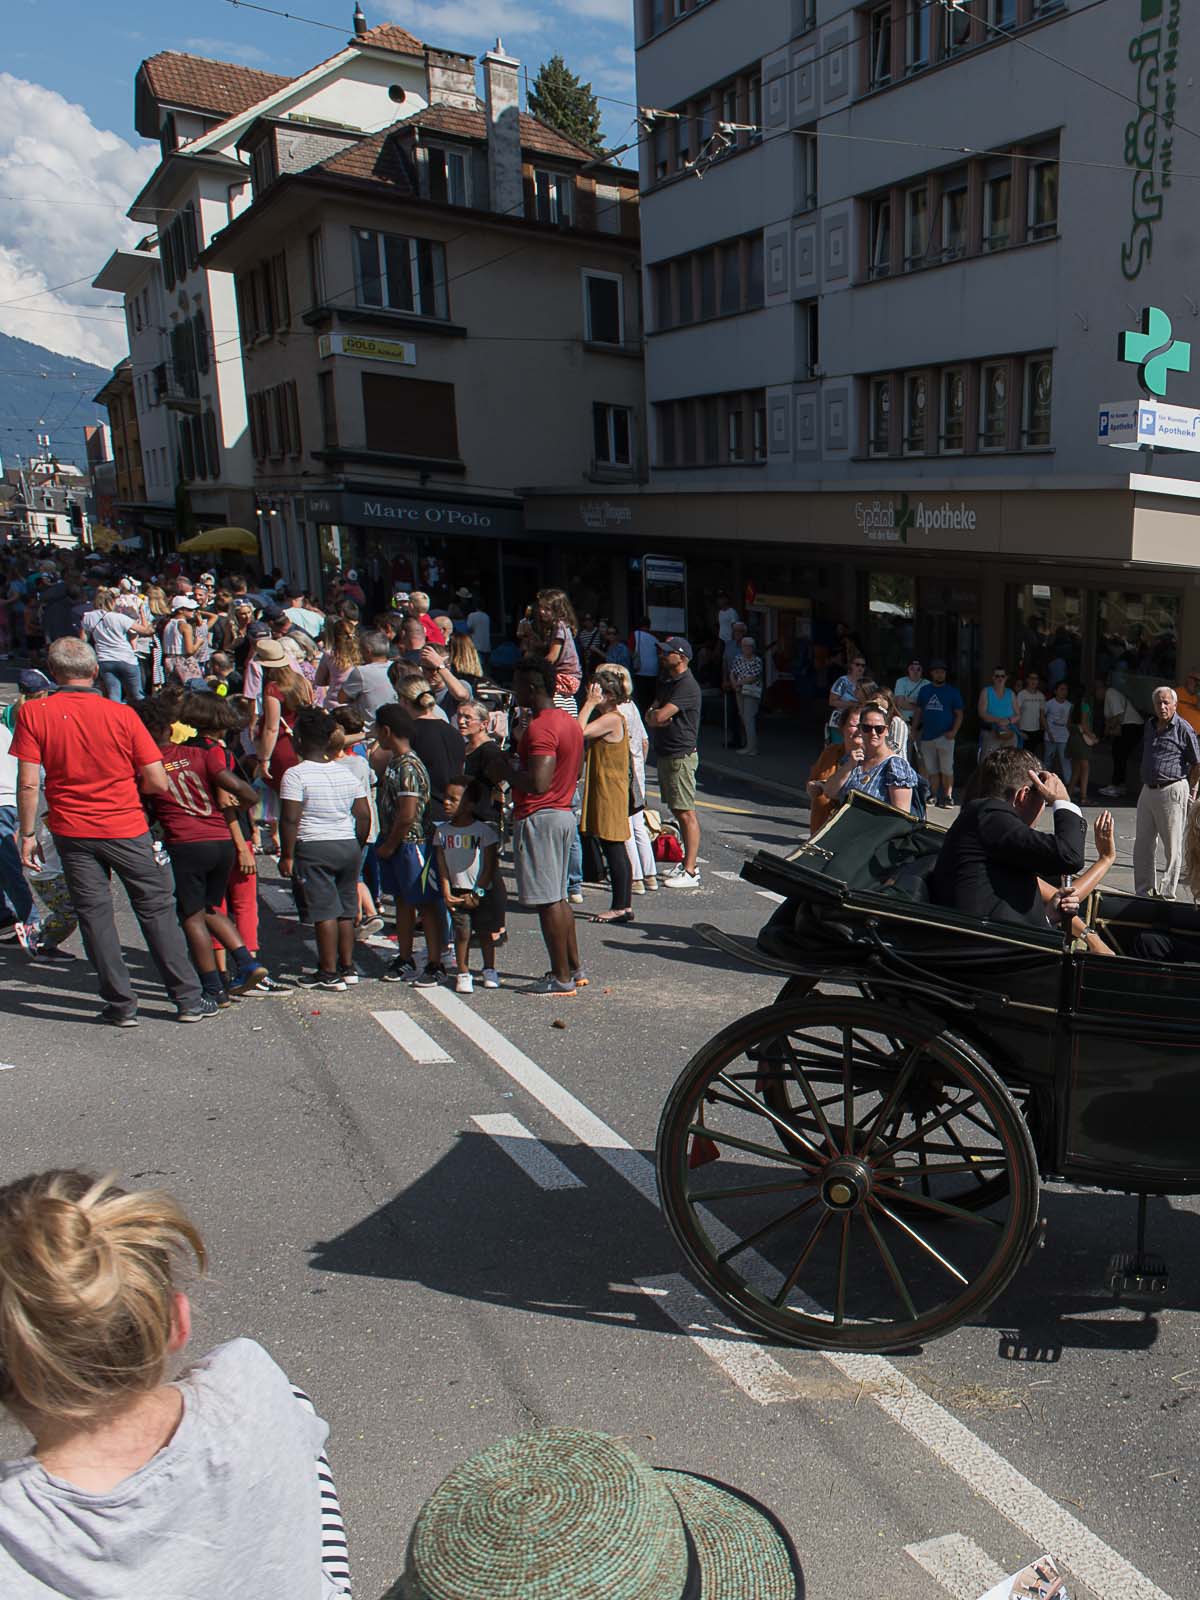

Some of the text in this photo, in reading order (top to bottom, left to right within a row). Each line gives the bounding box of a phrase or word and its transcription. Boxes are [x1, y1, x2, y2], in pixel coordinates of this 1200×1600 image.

[1163, 0, 1180, 72] Natu
[1121, 28, 1162, 281] Späni
[1158, 425, 1196, 437] Apotheke
[363, 502, 491, 528] Marc O'Polo
[856, 501, 977, 535] Späni Apotheke
